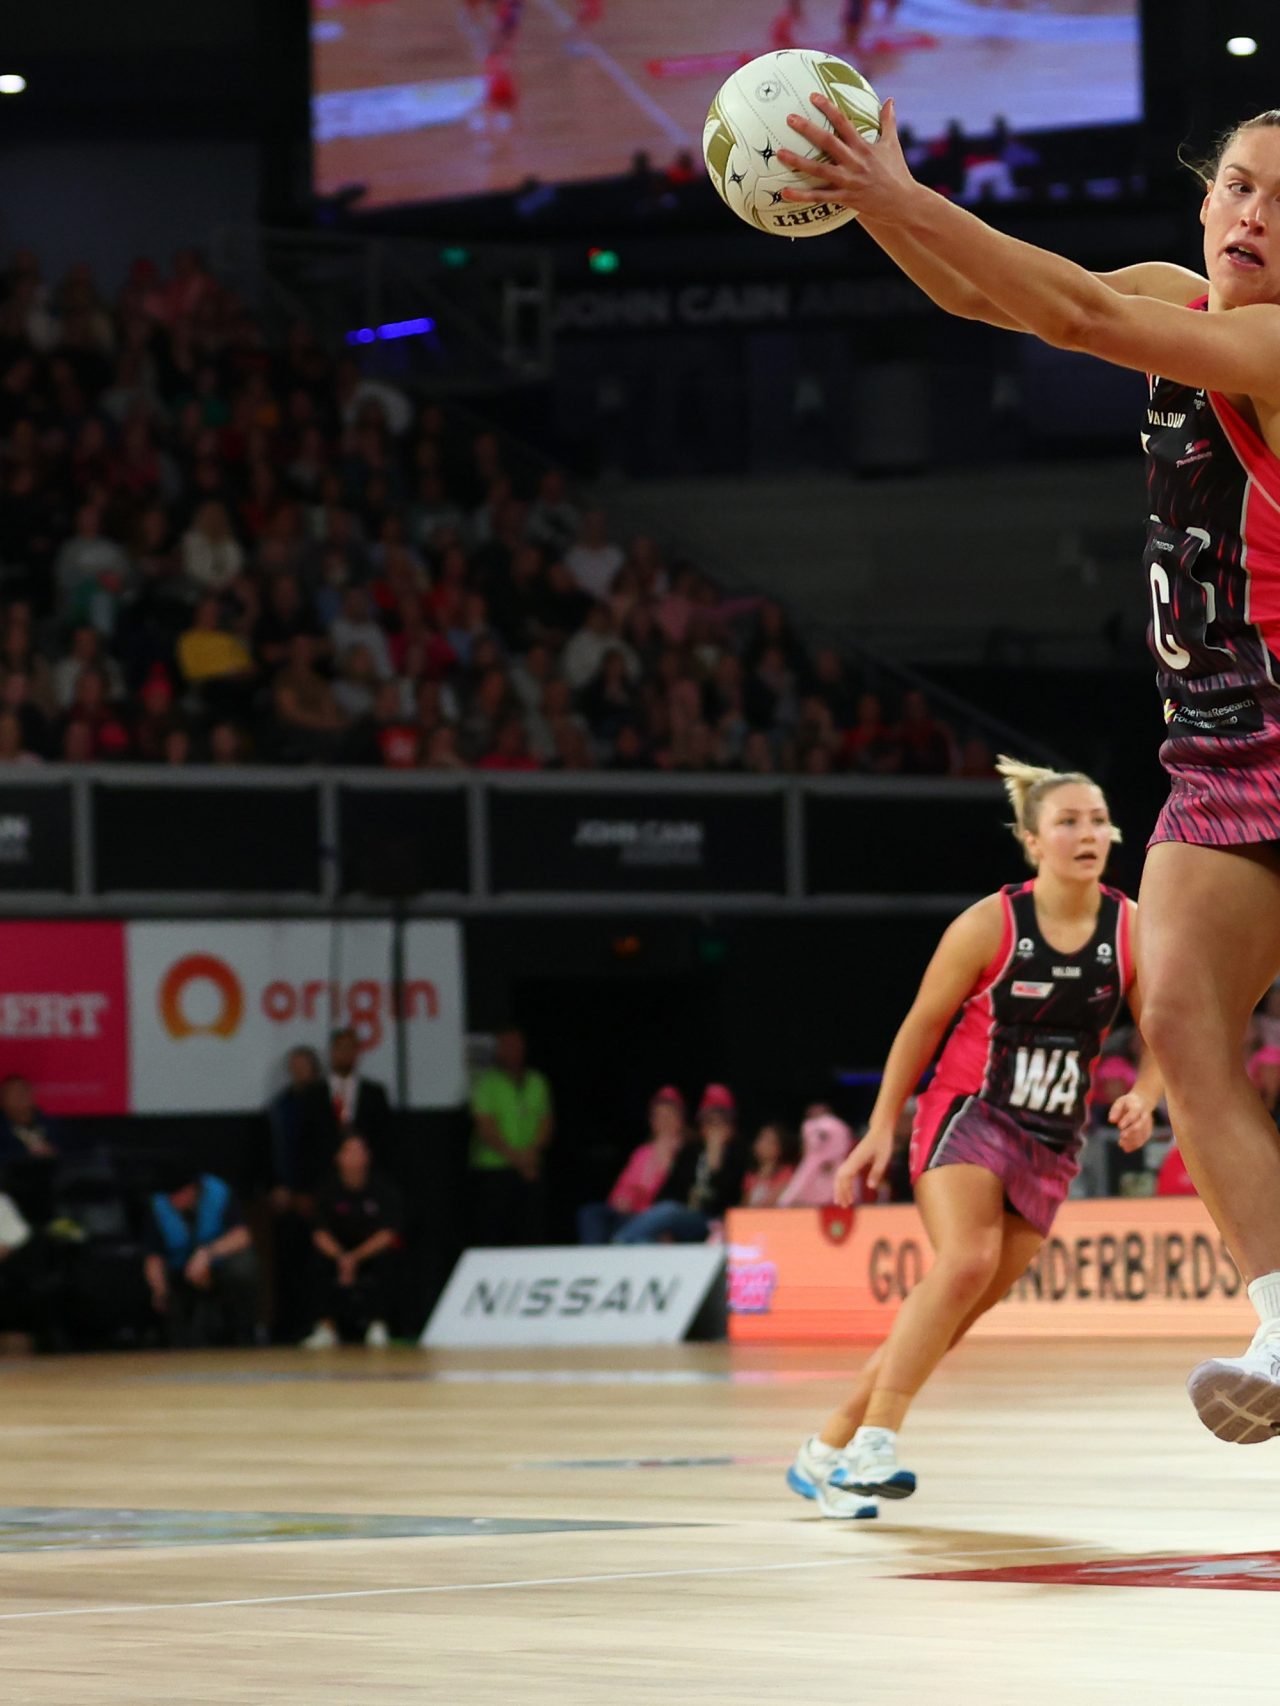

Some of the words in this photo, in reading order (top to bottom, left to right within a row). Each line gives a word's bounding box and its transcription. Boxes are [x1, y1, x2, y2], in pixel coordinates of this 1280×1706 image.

[1149, 562, 1191, 671] C
[1008, 1046, 1082, 1116] WA
[463, 1276, 682, 1318] NISSAN
[868, 1237, 923, 1304] GO
[1012, 1230, 1244, 1303] NDERBIRDS
